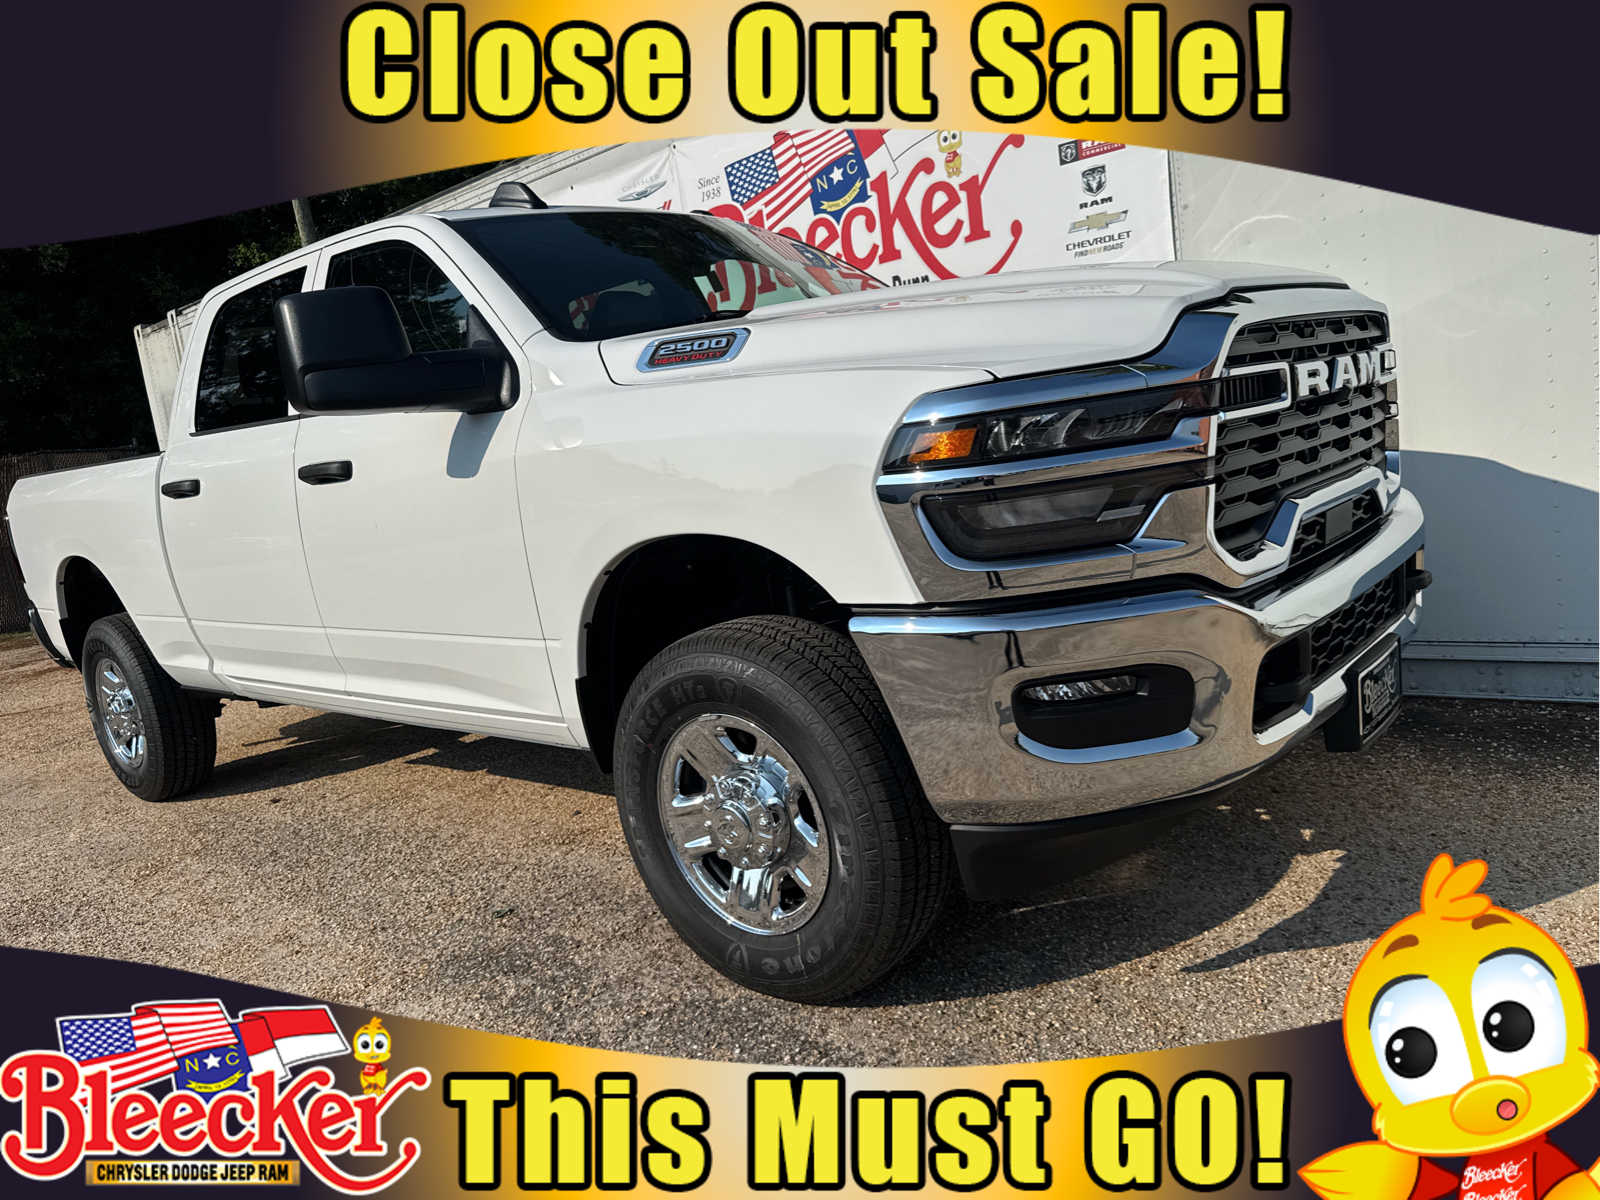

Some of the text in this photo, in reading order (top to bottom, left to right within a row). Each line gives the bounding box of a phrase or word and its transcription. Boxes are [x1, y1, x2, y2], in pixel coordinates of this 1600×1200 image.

[697, 175, 720, 189] Since
[702, 187, 721, 202] 1938
[1079, 196, 1113, 209] RAM
[1065, 230, 1132, 251] CHEVROLET
[659, 337, 728, 355] 2500
[654, 351, 723, 365] HEAVY DUTY
[1294, 351, 1382, 397] RAM
